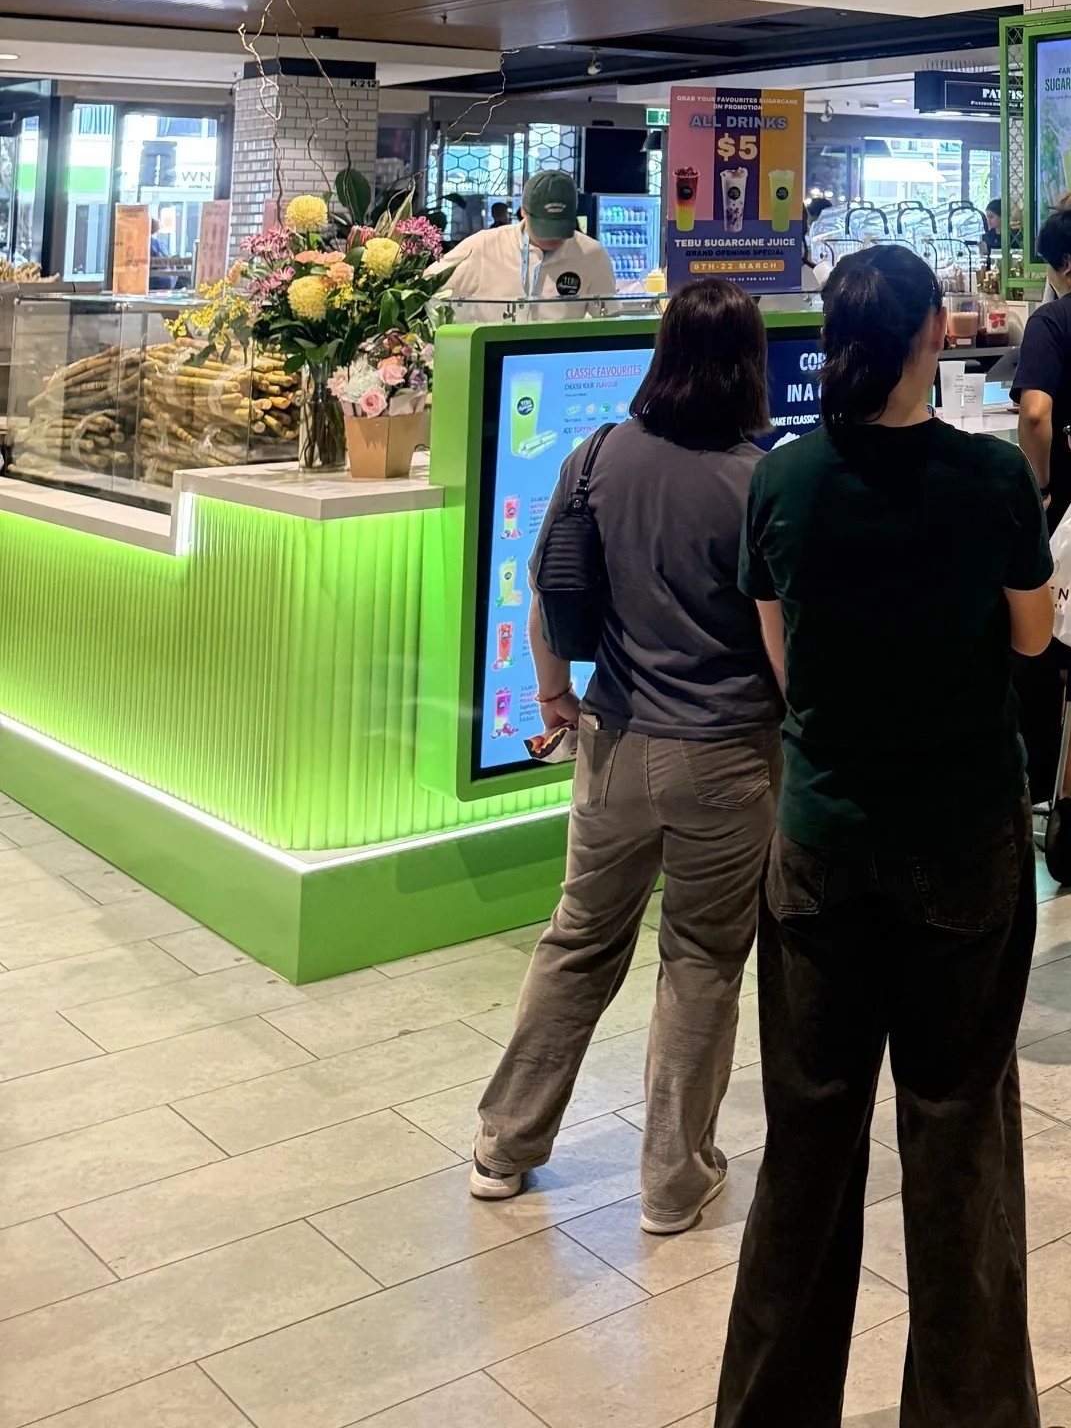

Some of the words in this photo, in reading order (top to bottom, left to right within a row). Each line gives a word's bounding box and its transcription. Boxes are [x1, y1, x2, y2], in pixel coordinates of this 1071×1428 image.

[691, 115, 722, 127] ALL
[726, 116, 788, 129] DRINKS
[717, 133, 758, 162] $5
[182, 172, 211, 182] WN
[674, 239, 702, 248] TEBU
[704, 238, 764, 247] SUGARCANE
[767, 238, 795, 246] JUICE
[739, 262, 777, 270] MARCH
[566, 367, 596, 380] CLASSIC
[597, 364, 642, 378] FAVOURITES
[787, 384, 802, 402] IN
[804, 383, 814, 401] A
[787, 416, 793, 425] IT
